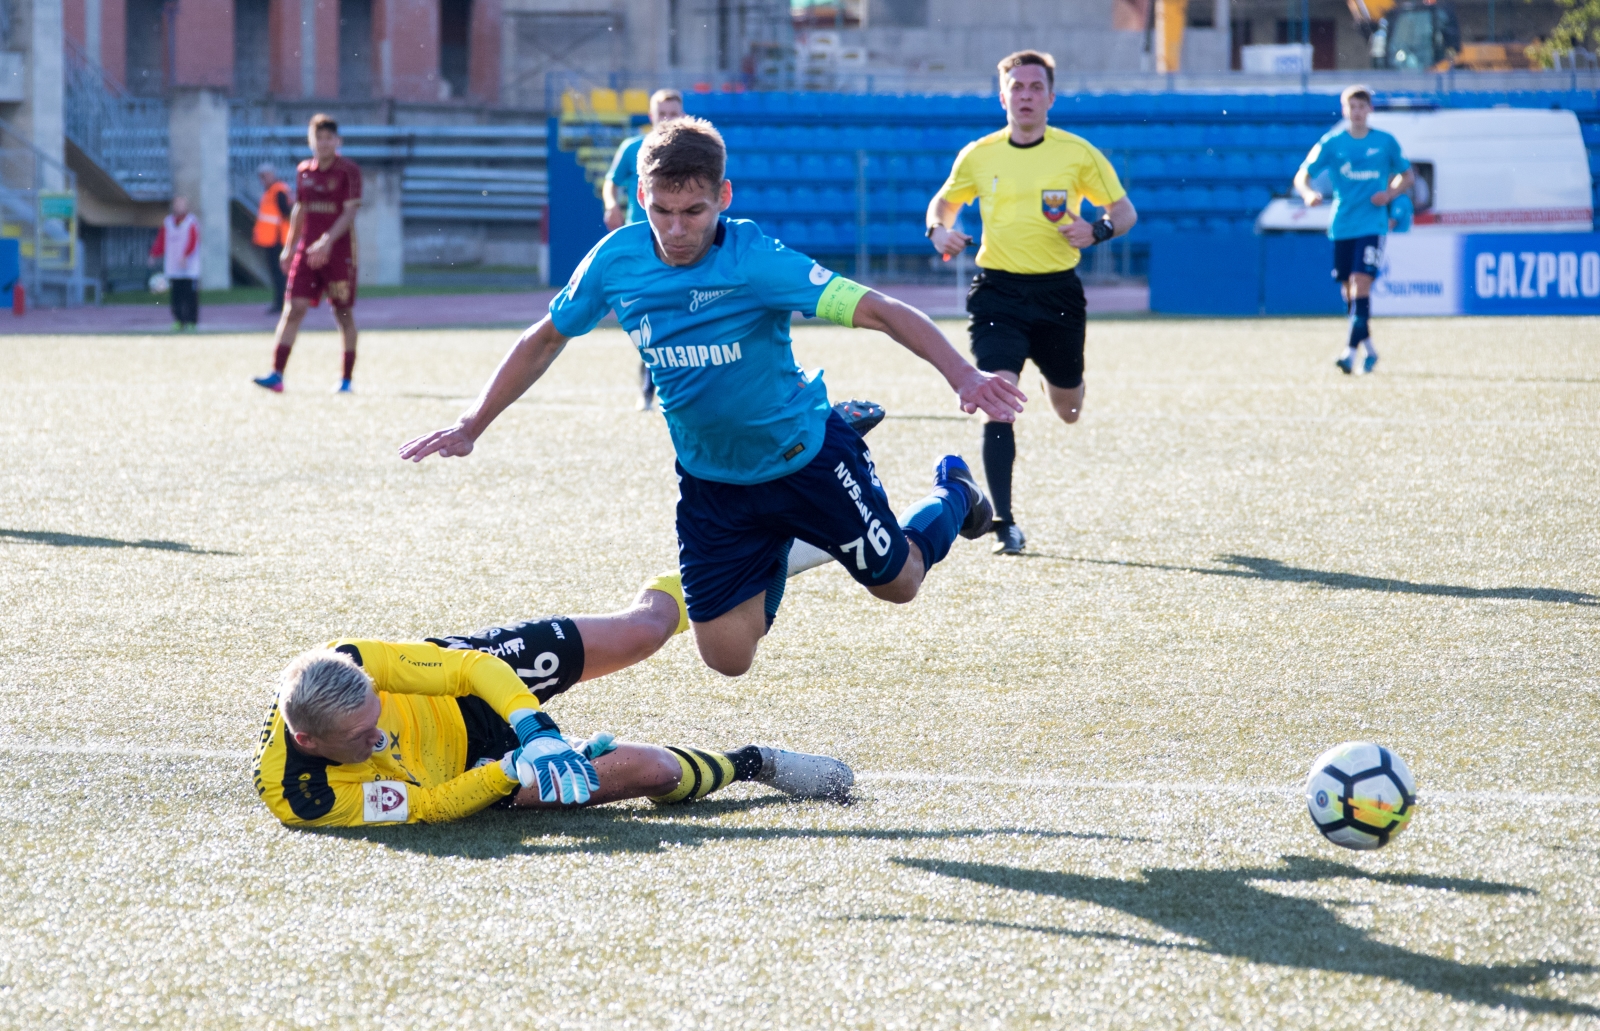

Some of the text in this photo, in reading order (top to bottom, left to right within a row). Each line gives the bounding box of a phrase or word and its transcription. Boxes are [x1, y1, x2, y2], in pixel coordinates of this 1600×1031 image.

[1475, 251, 1600, 297] GAZPRO
[657, 341, 742, 368] ГАЗПРОМ
[839, 518, 891, 570] 76
